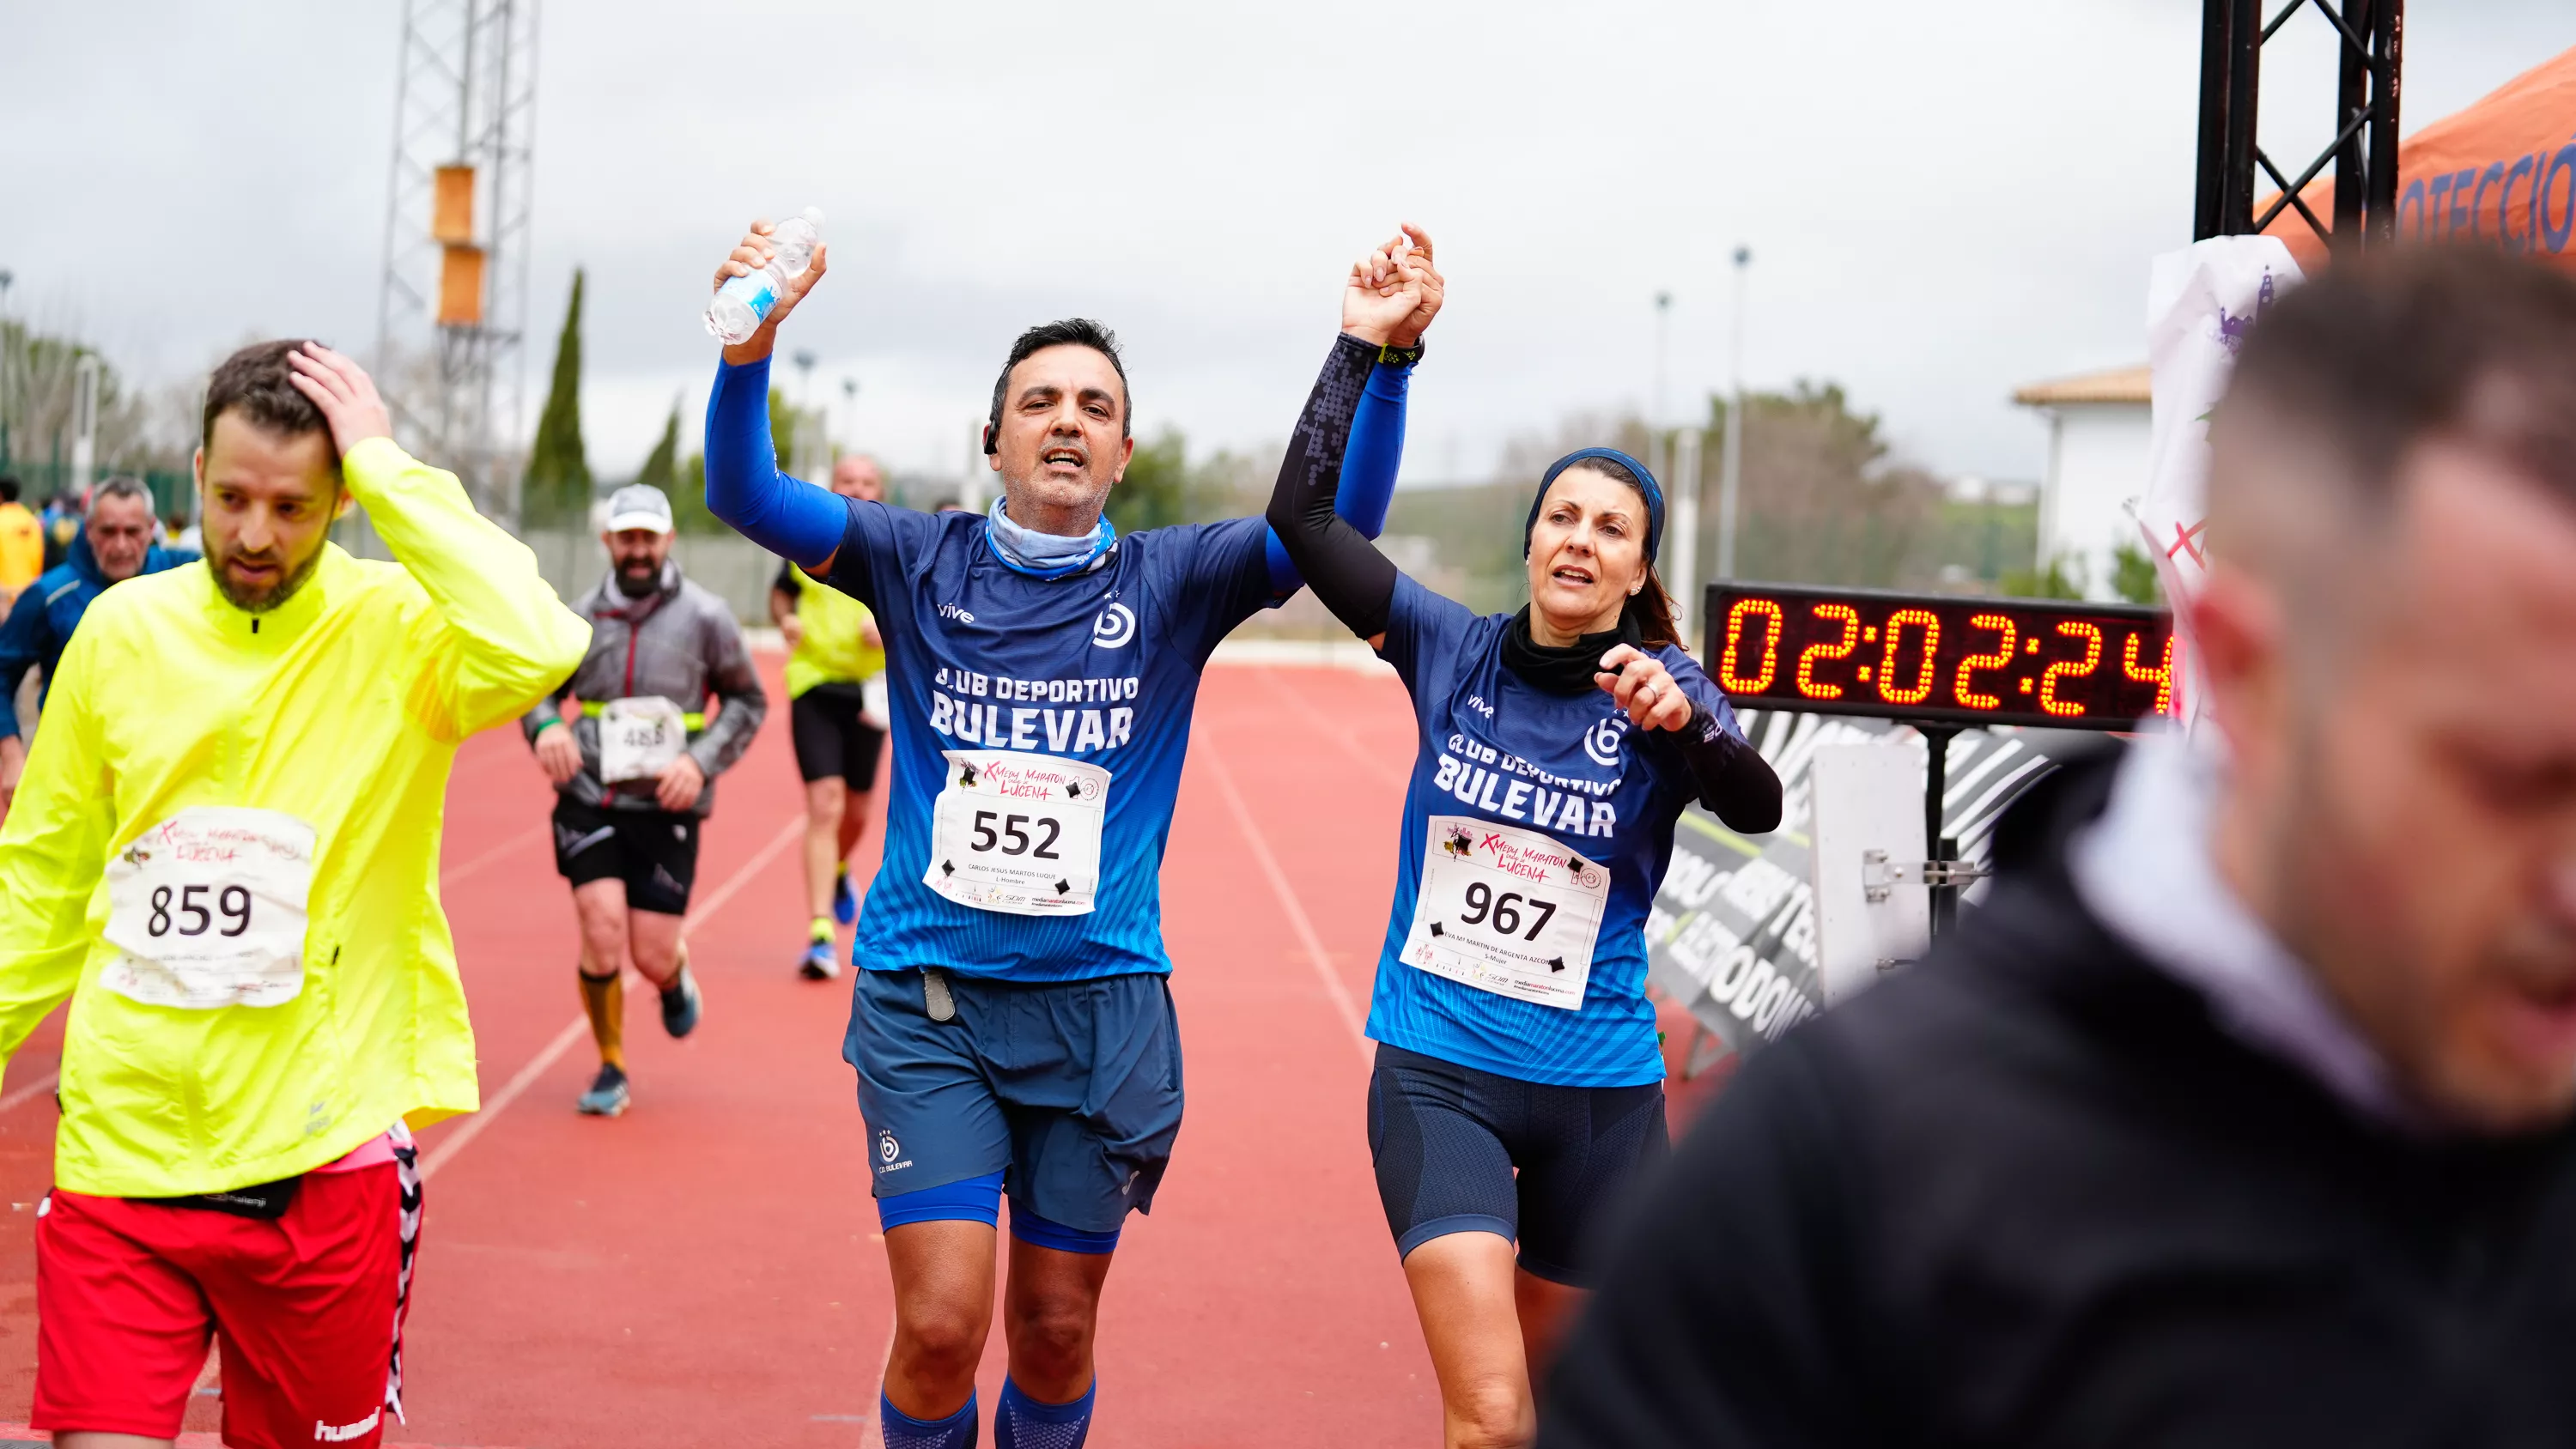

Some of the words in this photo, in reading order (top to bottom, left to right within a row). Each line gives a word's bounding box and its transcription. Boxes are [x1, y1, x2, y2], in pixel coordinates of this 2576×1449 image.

[938, 603, 975, 624] vive
[1720, 598, 2174, 715] 02:02:24
[996, 676, 1139, 703] DEPORTIVO
[930, 690, 1134, 753] BULEVAR
[1000, 779, 1054, 801] LUCENA
[1433, 753, 1617, 838] BULEVAR
[971, 810, 1060, 860] 552
[968, 864, 989, 872] CARLOS
[1009, 869, 1036, 878] MARTOS
[1498, 854, 1551, 883] LUCENA
[1522, 847, 1568, 869] MARATÓN
[995, 876, 1025, 885] L-Hombre
[149, 884, 251, 937] 859
[1461, 882, 1556, 942] 967
[1444, 931, 1456, 941] EVA
[1466, 938, 1490, 951] MARTIN
[1490, 945, 1498, 954] DE
[1499, 948, 1528, 961] ARGENTA
[1514, 979, 1576, 996] mediamaratonlucena.com
[886, 1161, 913, 1172] BULEVAR
